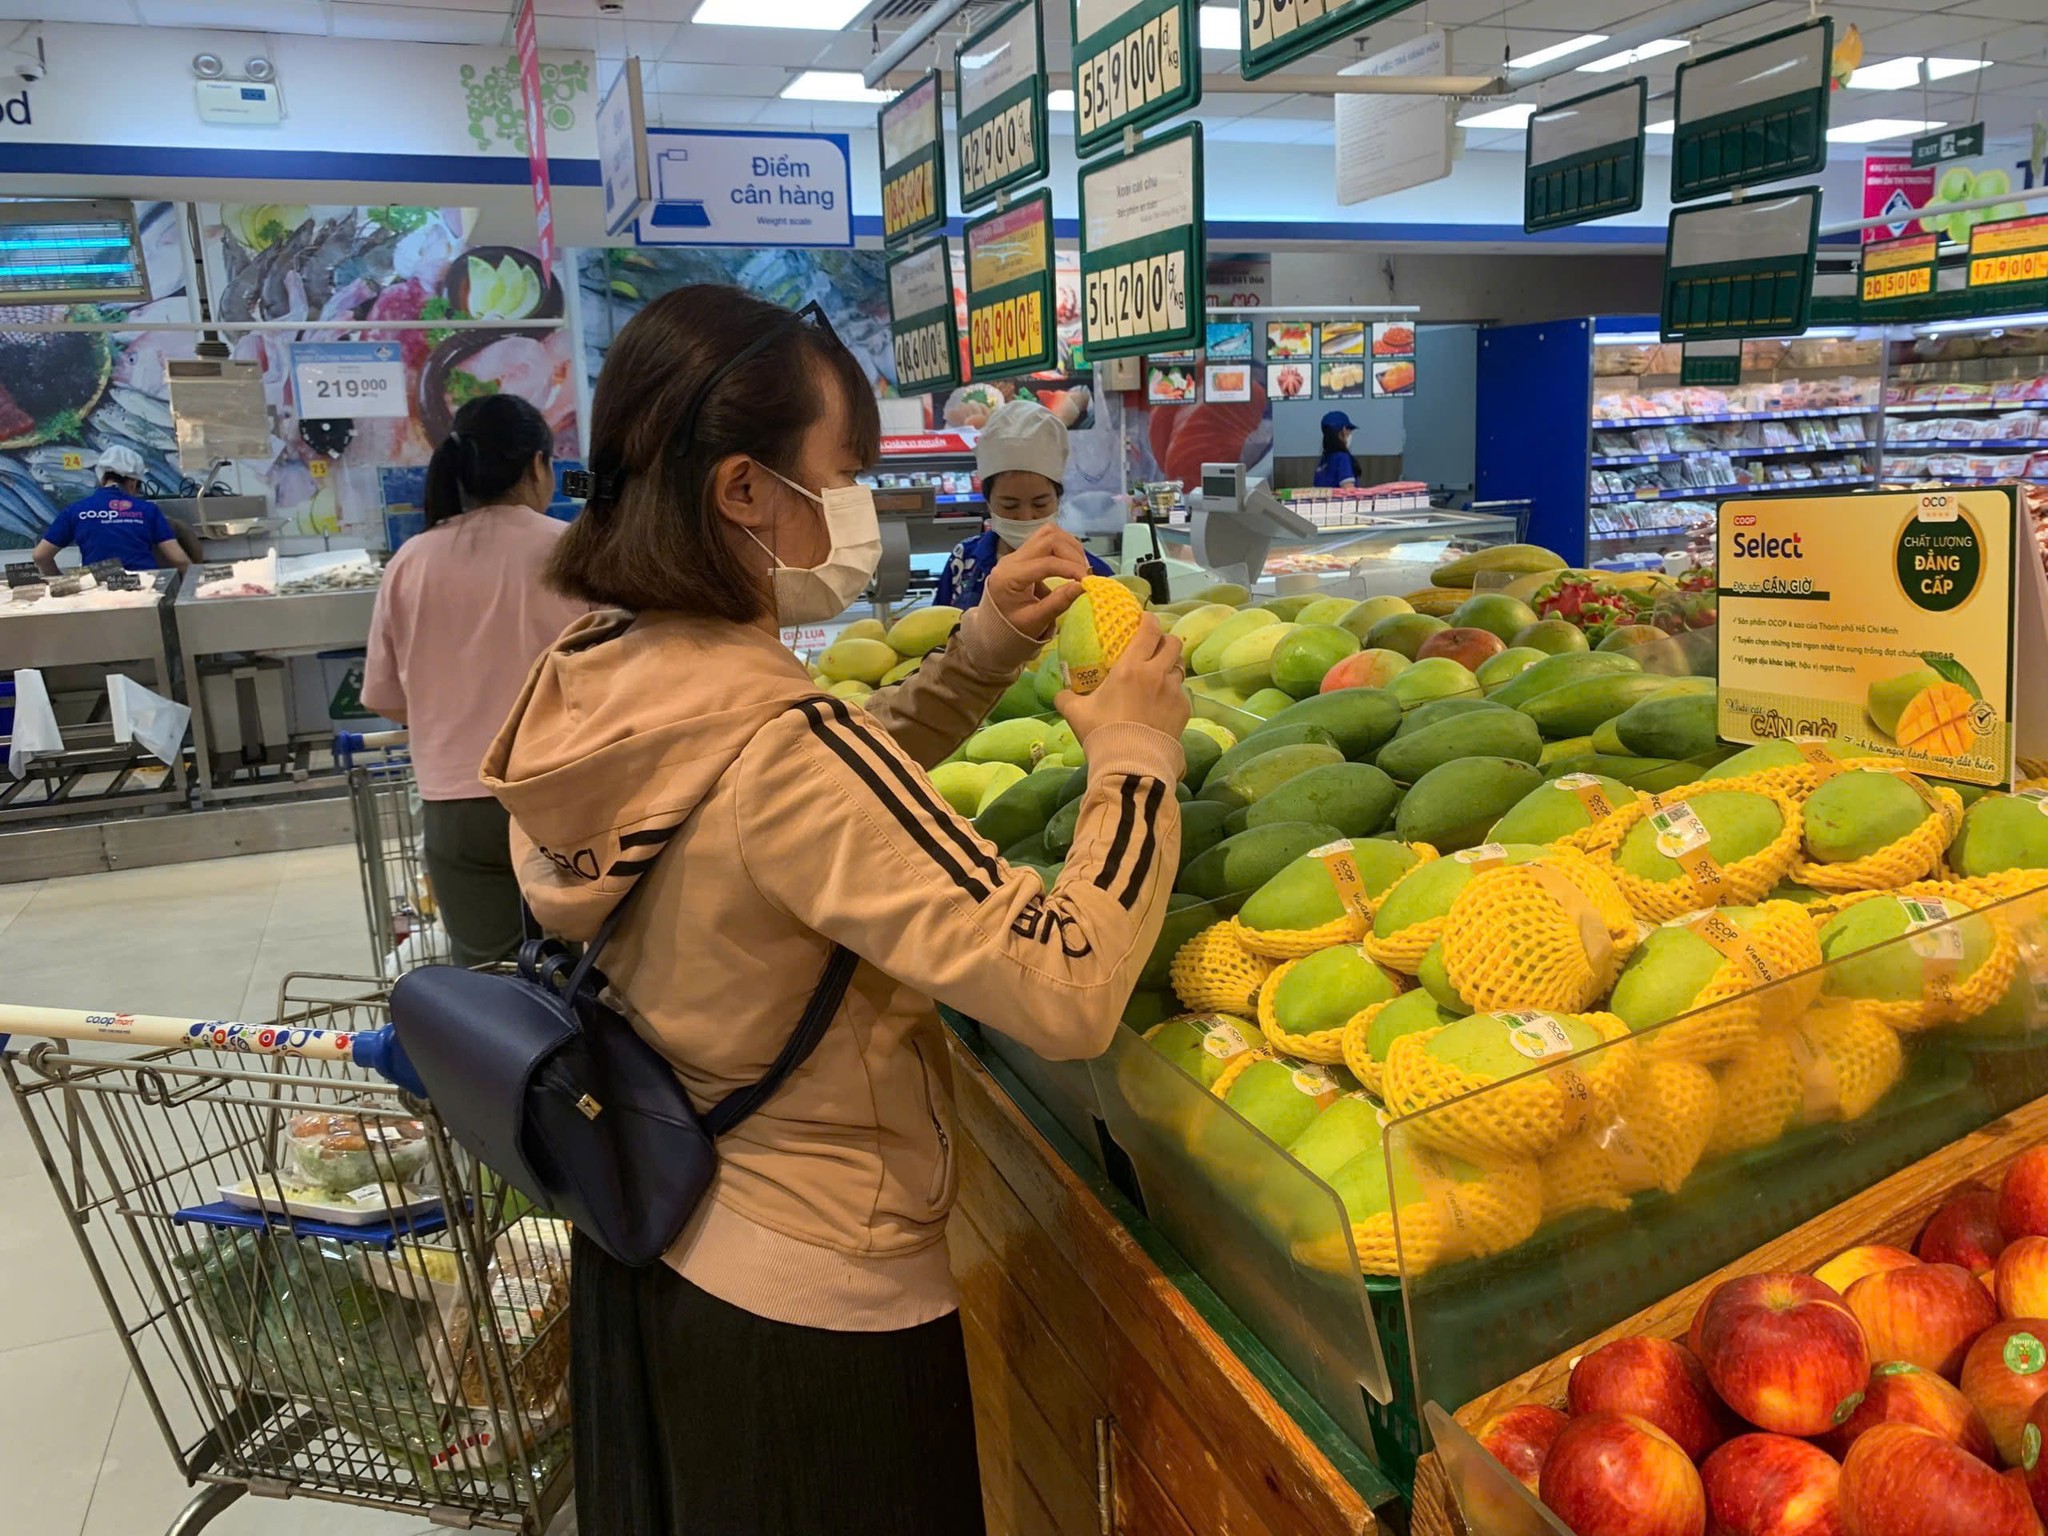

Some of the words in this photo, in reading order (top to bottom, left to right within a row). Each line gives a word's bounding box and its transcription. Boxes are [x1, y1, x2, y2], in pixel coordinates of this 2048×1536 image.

[1084, 34, 1155, 119] 55.900
[964, 117, 1016, 182] 42.900
[1918, 143, 1938, 158] EXIT
[752, 154, 810, 177] Điểm
[731, 184, 771, 204] cân
[780, 185, 834, 210] hàng
[757, 216, 787, 227] Weight
[789, 216, 812, 226] scale
[1975, 258, 2032, 278] 17.900
[1090, 265, 1163, 326] 51.200
[1866, 274, 1917, 296] 20.500
[974, 302, 1026, 355] 28.900
[64, 456, 80, 468] 24
[312, 463, 326, 474] 25
[1922, 496, 1954, 508] OCOP
[1734, 516, 1755, 525] COOP
[1734, 532, 1803, 558] Select
[1904, 533, 1931, 547] CHẤT
[1934, 535, 1972, 549] LƯỢNG
[1915, 549, 1960, 571] ĐẲNG
[1790, 577, 1812, 593] GIỜ
[1921, 577, 1953, 595] CẤP
[1768, 619, 1787, 627] OCOP
[1077, 669, 1098, 679] OCOP
[1751, 709, 1792, 738] CẦN
[1340, 859, 1356, 882] OCOP
[1709, 918, 1738, 939] OCOP
[1745, 945, 1772, 982] VietGAP
